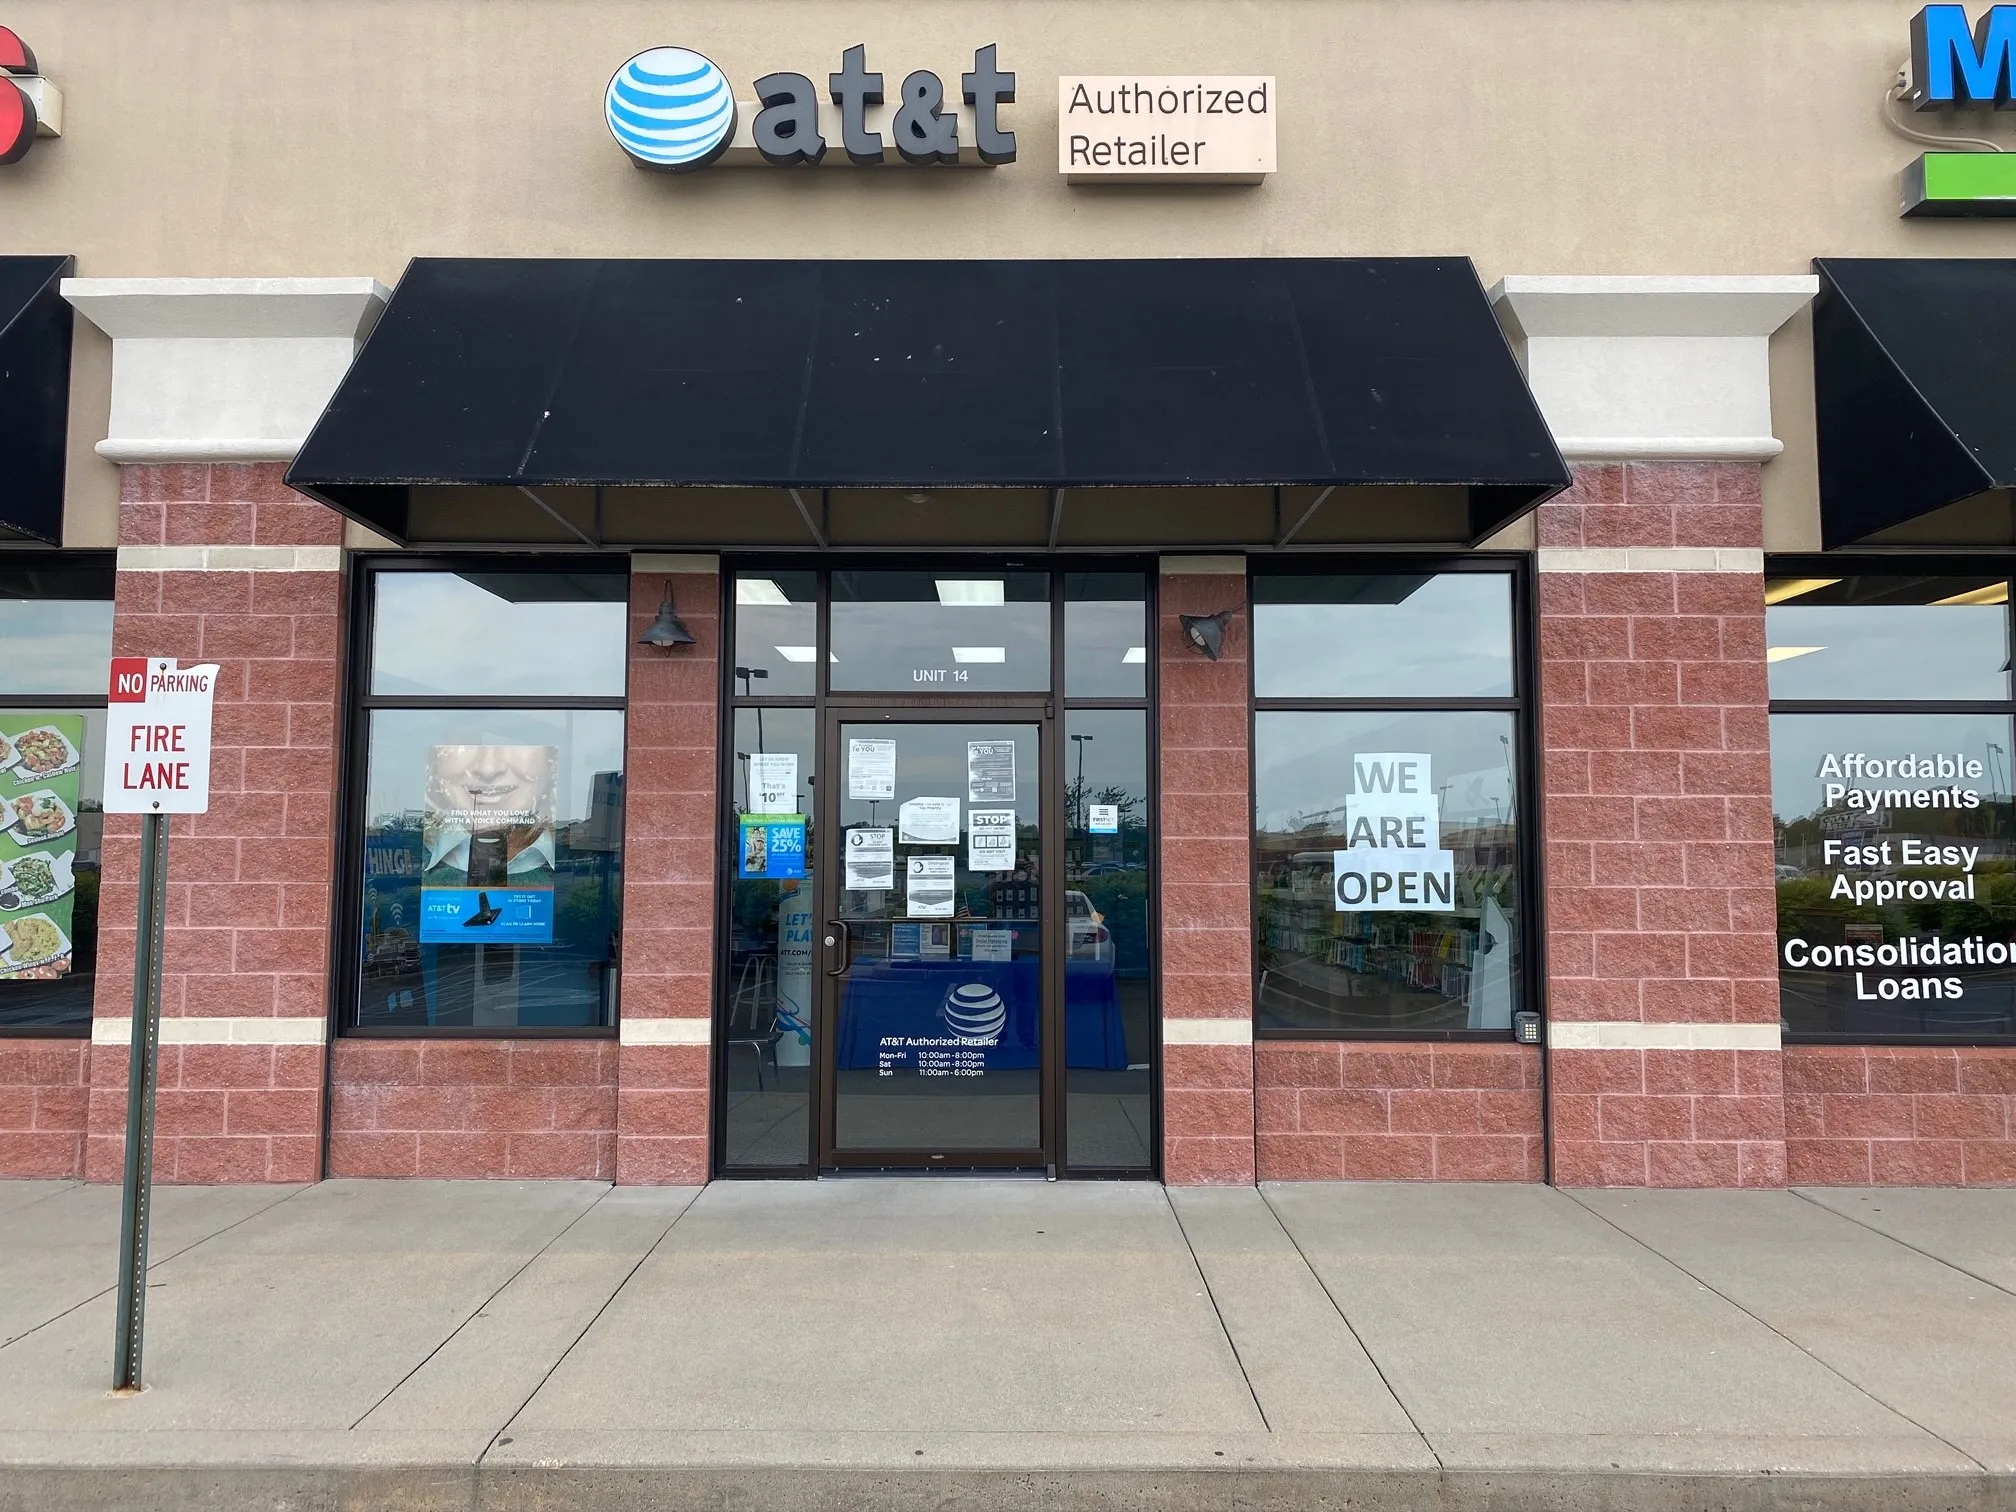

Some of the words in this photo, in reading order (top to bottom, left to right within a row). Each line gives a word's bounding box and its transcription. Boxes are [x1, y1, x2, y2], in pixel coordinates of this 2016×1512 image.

[753, 43, 1016, 164] at&t
[1068, 83, 1268, 114] Authorized
[1069, 135, 1206, 165] Retailer
[118, 673, 144, 694] NO
[150, 674, 208, 693] PARKING
[913, 669, 947, 682] UNIT
[953, 669, 969, 682] 14
[131, 725, 187, 752] FIRE
[123, 762, 190, 790] LANE
[1355, 761, 1418, 794] WE
[1819, 753, 1983, 779] Affordable
[1826, 783, 1980, 815] Payments
[772, 828, 800, 838] SAVE
[976, 816, 1007, 824] STOP
[1348, 816, 1426, 848] ARE
[772, 838, 802, 852] 25%
[1824, 839, 1892, 866] Fast
[1902, 839, 1979, 872] Easy
[1337, 871, 1450, 904] OPEN
[1830, 873, 1975, 906] Approval
[447, 903, 460, 914] tv
[786, 930, 813, 942] PLA
[1855, 971, 1964, 1001] Loans
[880, 1037, 904, 1046] AT&T
[906, 1037, 960, 1046] Authorized
[961, 1037, 998, 1046] Retailer
[955, 1052, 984, 1060] 8:00pm
[955, 1061, 984, 1069] 8:00pm
